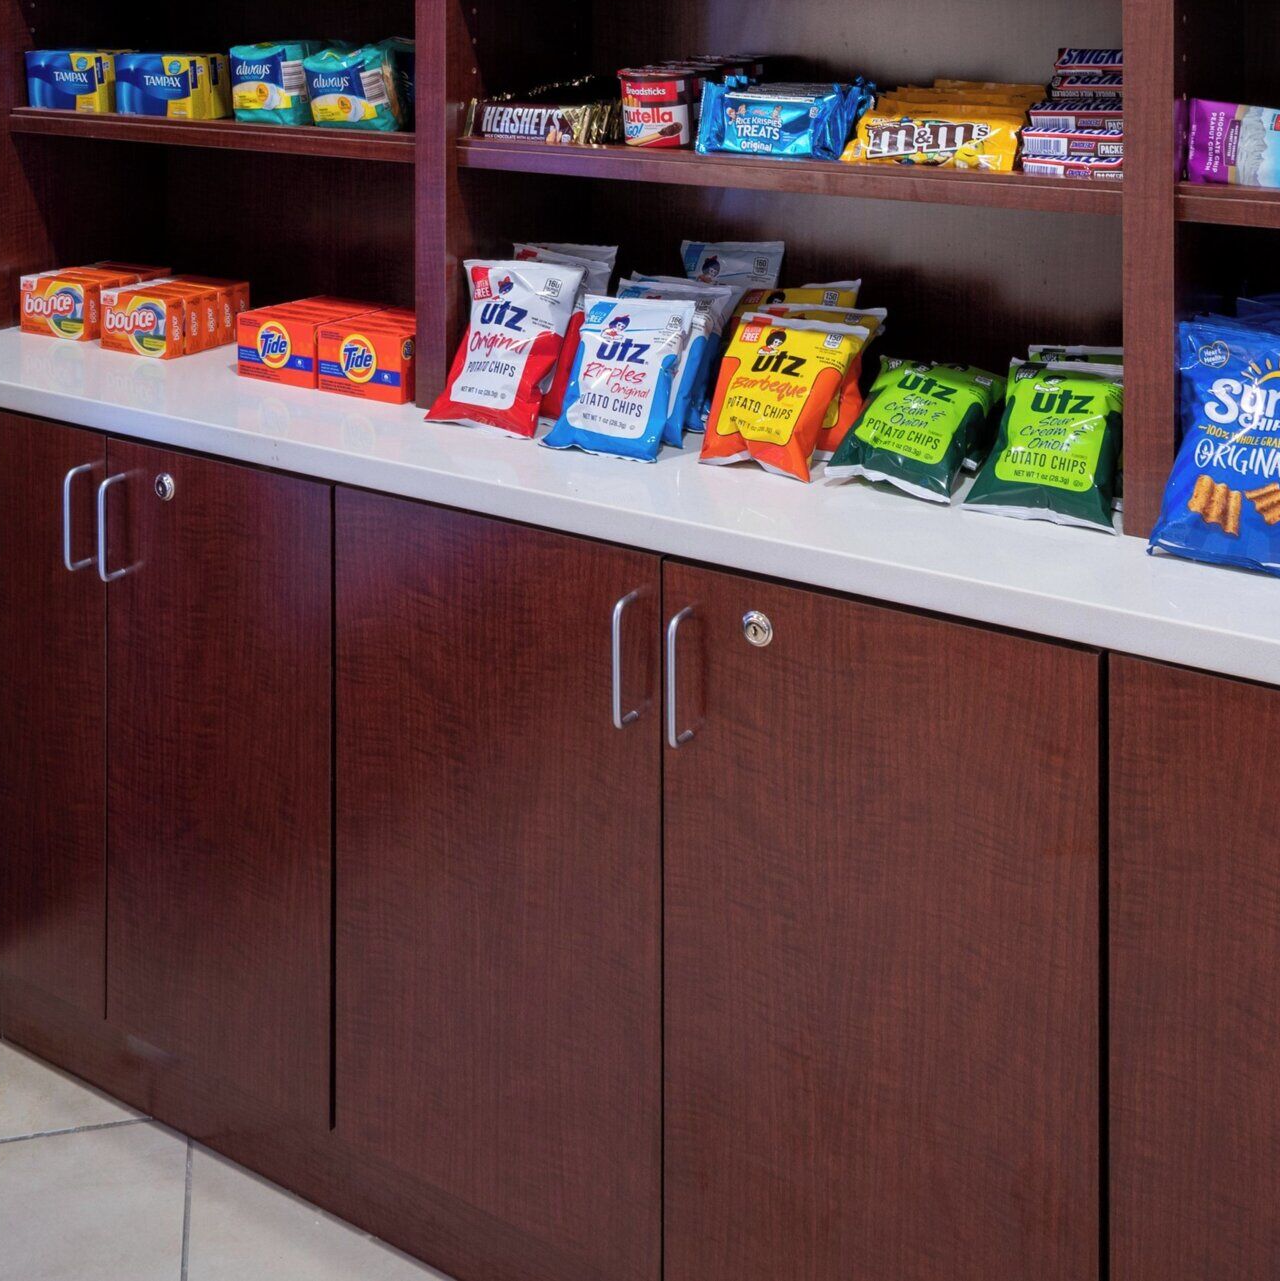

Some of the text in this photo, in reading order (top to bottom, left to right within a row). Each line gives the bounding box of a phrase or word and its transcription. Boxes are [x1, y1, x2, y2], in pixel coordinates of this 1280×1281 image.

[53, 71, 88, 83] TAMPAX
[236, 61, 271, 77] always
[144, 75, 181, 87] TAMPAX
[313, 74, 349, 90] always
[481, 105, 563, 135] HERSHEY'S
[624, 107, 673, 124] nutella
[752, 117, 782, 128] KRISPIES
[737, 125, 780, 140] TREATS
[741, 141, 772, 152] Original
[25, 293, 74, 314] bounce
[105, 308, 155, 331] bounce
[261, 332, 287, 357] Tide
[741, 332, 760, 343] FREE
[344, 345, 373, 370] Tide
[583, 362, 646, 385] Ripples
[731, 375, 808, 400] Barbeque
[903, 393, 939, 407] Sour
[884, 403, 929, 419] Cream
[891, 414, 929, 429] Onion
[866, 417, 941, 450] POTATO CHIPS
[1004, 449, 1087, 475] POTATO CHIPS
